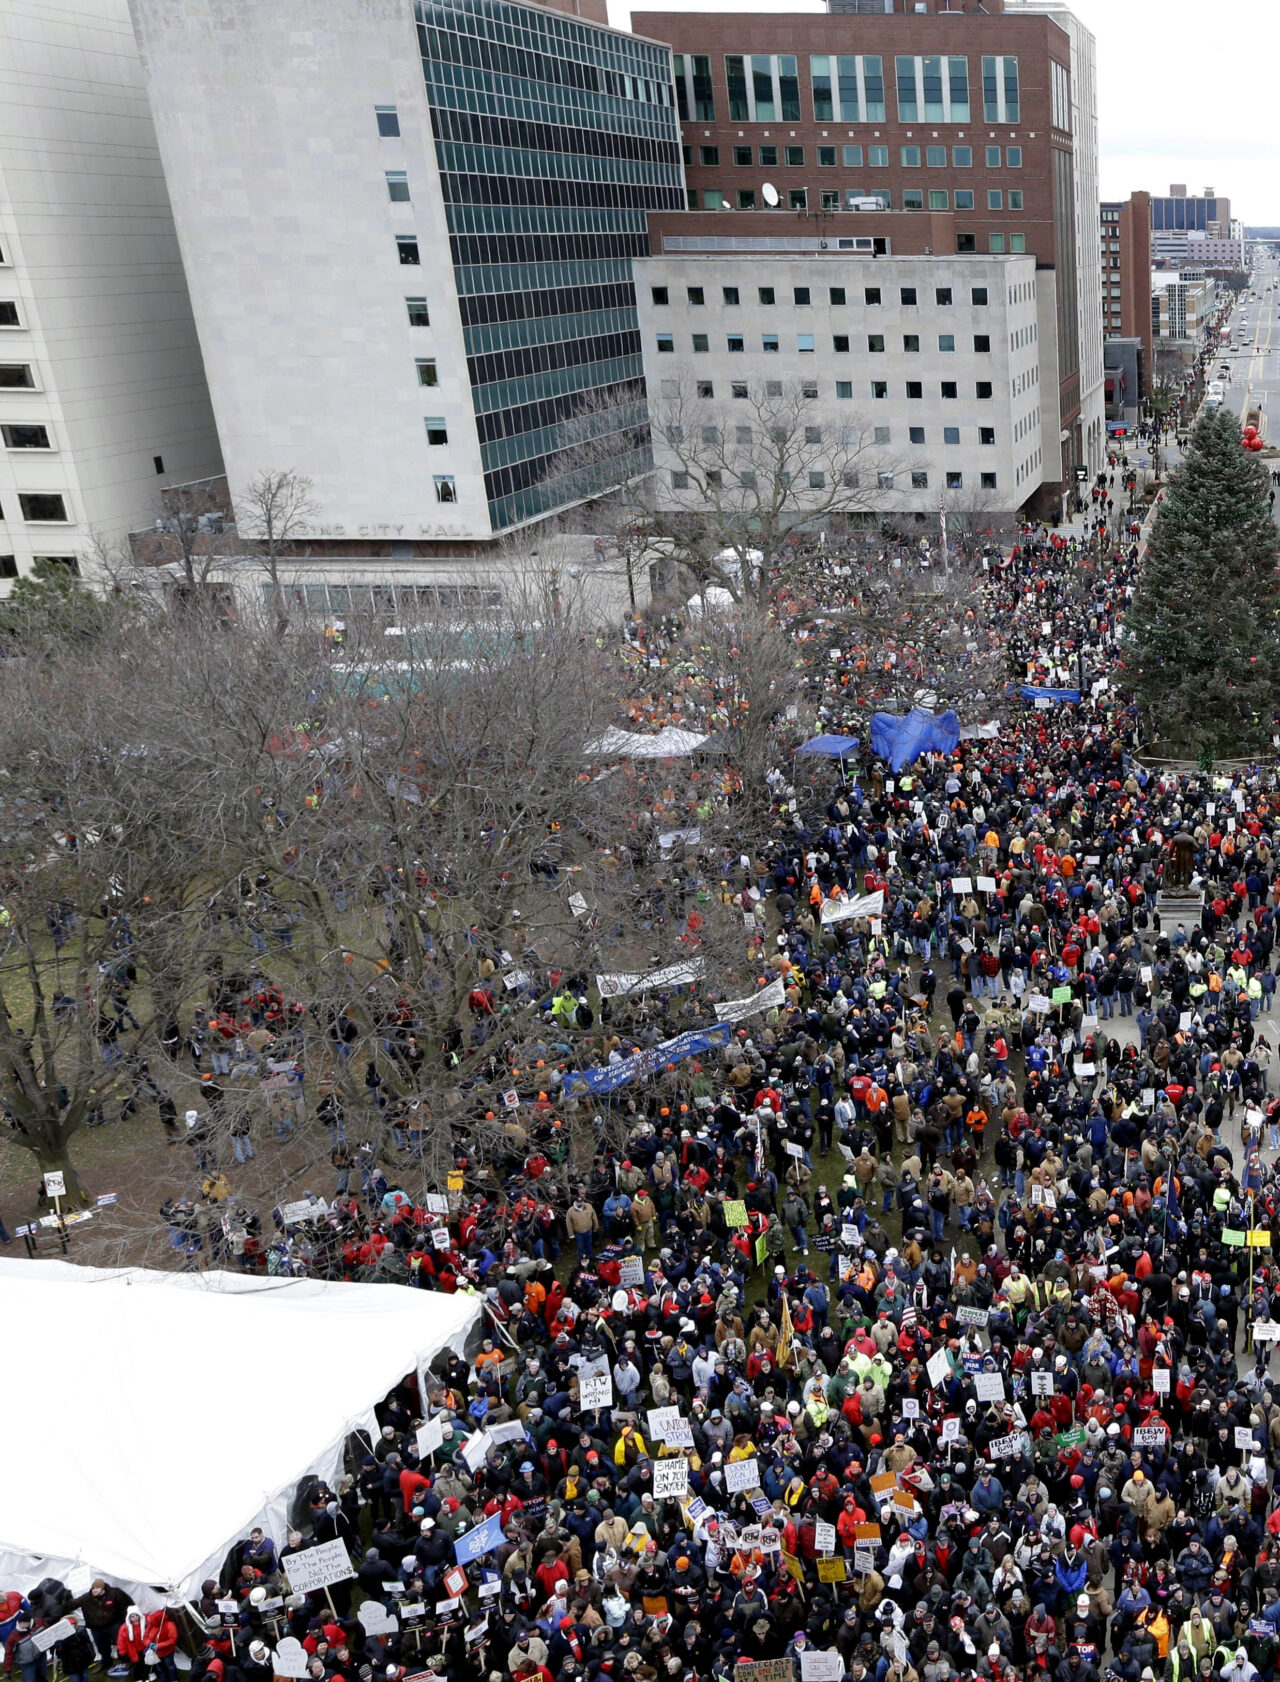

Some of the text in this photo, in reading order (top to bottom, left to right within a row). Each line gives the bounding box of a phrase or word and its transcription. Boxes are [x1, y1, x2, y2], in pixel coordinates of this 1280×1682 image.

[357, 524, 405, 538] CITY
[418, 525, 473, 538] HALL
[580, 1272, 598, 1280] STOP
[959, 1308, 987, 1318] YOOPERS
[962, 1352, 981, 1360] STOP
[965, 1361, 980, 1369] WAR
[585, 1378, 608, 1389] RTW
[582, 1389, 610, 1398] WRONG
[661, 1418, 690, 1432] UNION
[666, 1430, 692, 1442] STRONG
[991, 1434, 1018, 1448] IBEW
[656, 1459, 686, 1471] SHAME
[729, 1462, 752, 1473] DON'T
[655, 1470, 687, 1483] ON YOU
[728, 1468, 757, 1481] SIGN IT
[656, 1481, 686, 1493] SNYDER
[522, 1497, 544, 1506] STOP
[528, 1504, 545, 1513] WAR
[744, 1532, 759, 1541] RTW
[762, 1536, 777, 1545] RTW
[285, 1557, 297, 1566] By
[297, 1551, 315, 1562] The
[287, 1565, 299, 1575] For
[301, 1560, 317, 1571] The
[308, 1562, 341, 1580] Not The
[1077, 1645, 1094, 1653] TOP
[736, 1662, 763, 1671] MIDDLE
[758, 1668, 772, 1676] ONE
[764, 1671, 787, 1681] TIME
